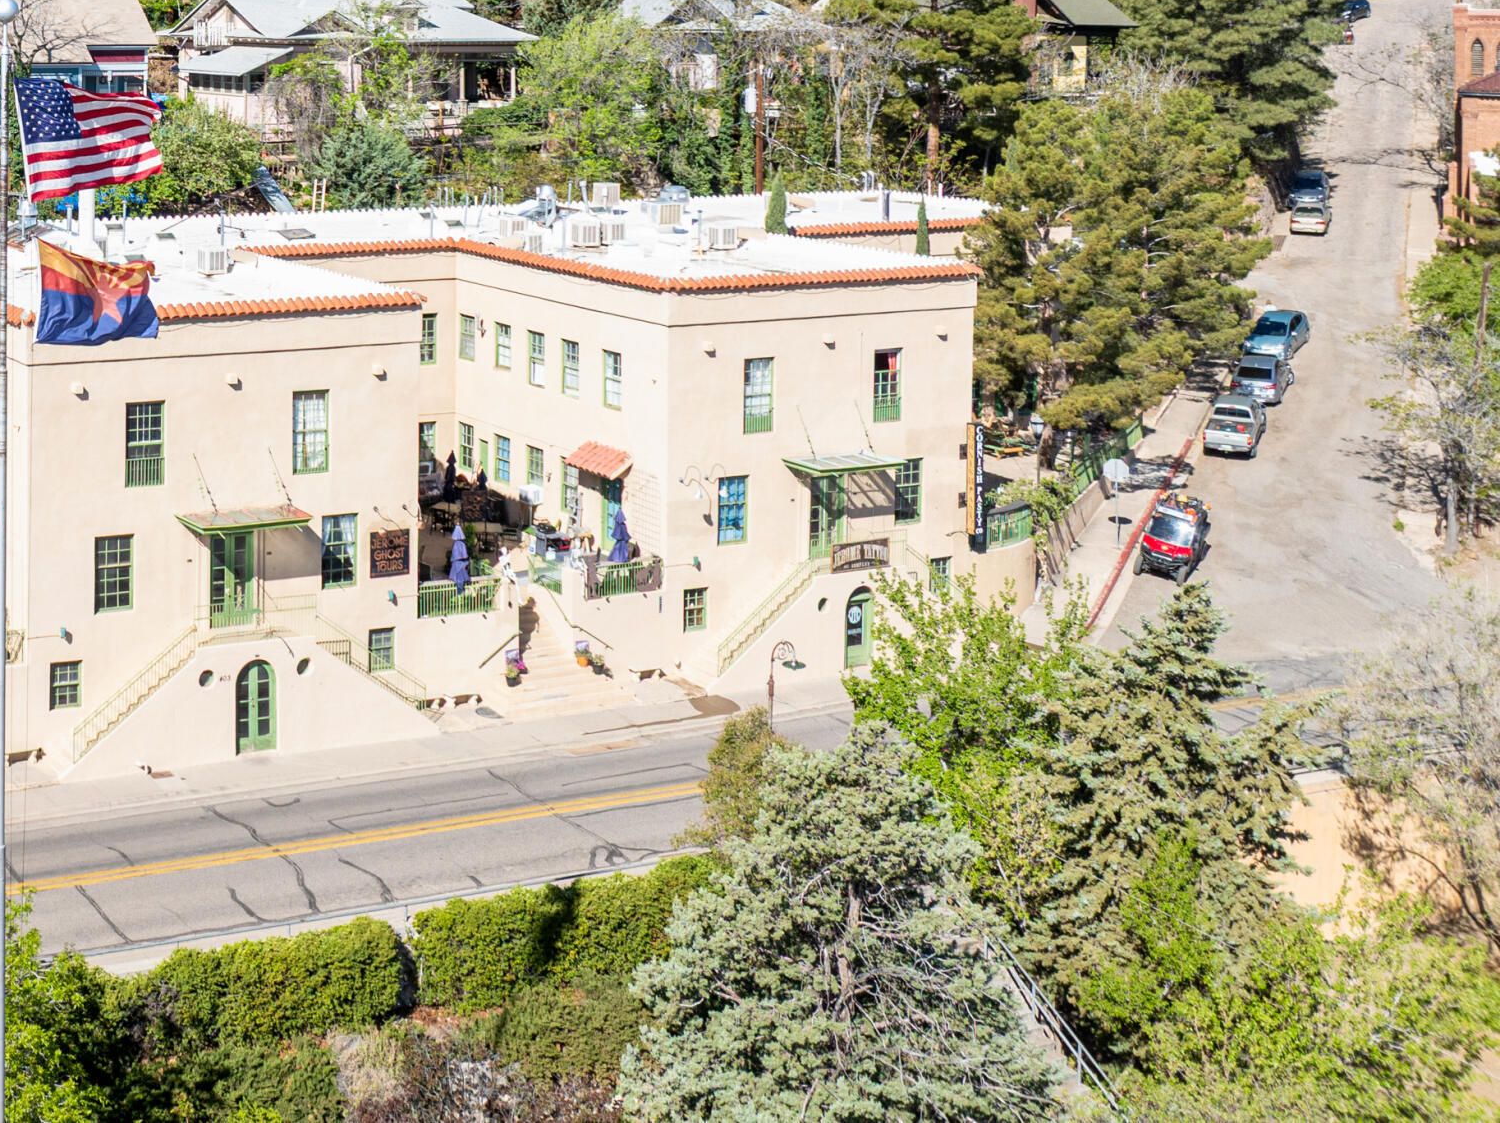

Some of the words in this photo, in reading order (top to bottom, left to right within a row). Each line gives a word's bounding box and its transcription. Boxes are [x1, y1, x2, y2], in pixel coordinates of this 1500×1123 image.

[975, 425, 984, 484] CORNISH
[975, 486, 984, 527] PASTY
[371, 535, 409, 549] JEROME
[373, 547, 405, 561] GHOST
[376, 559, 404, 572] TOURS
